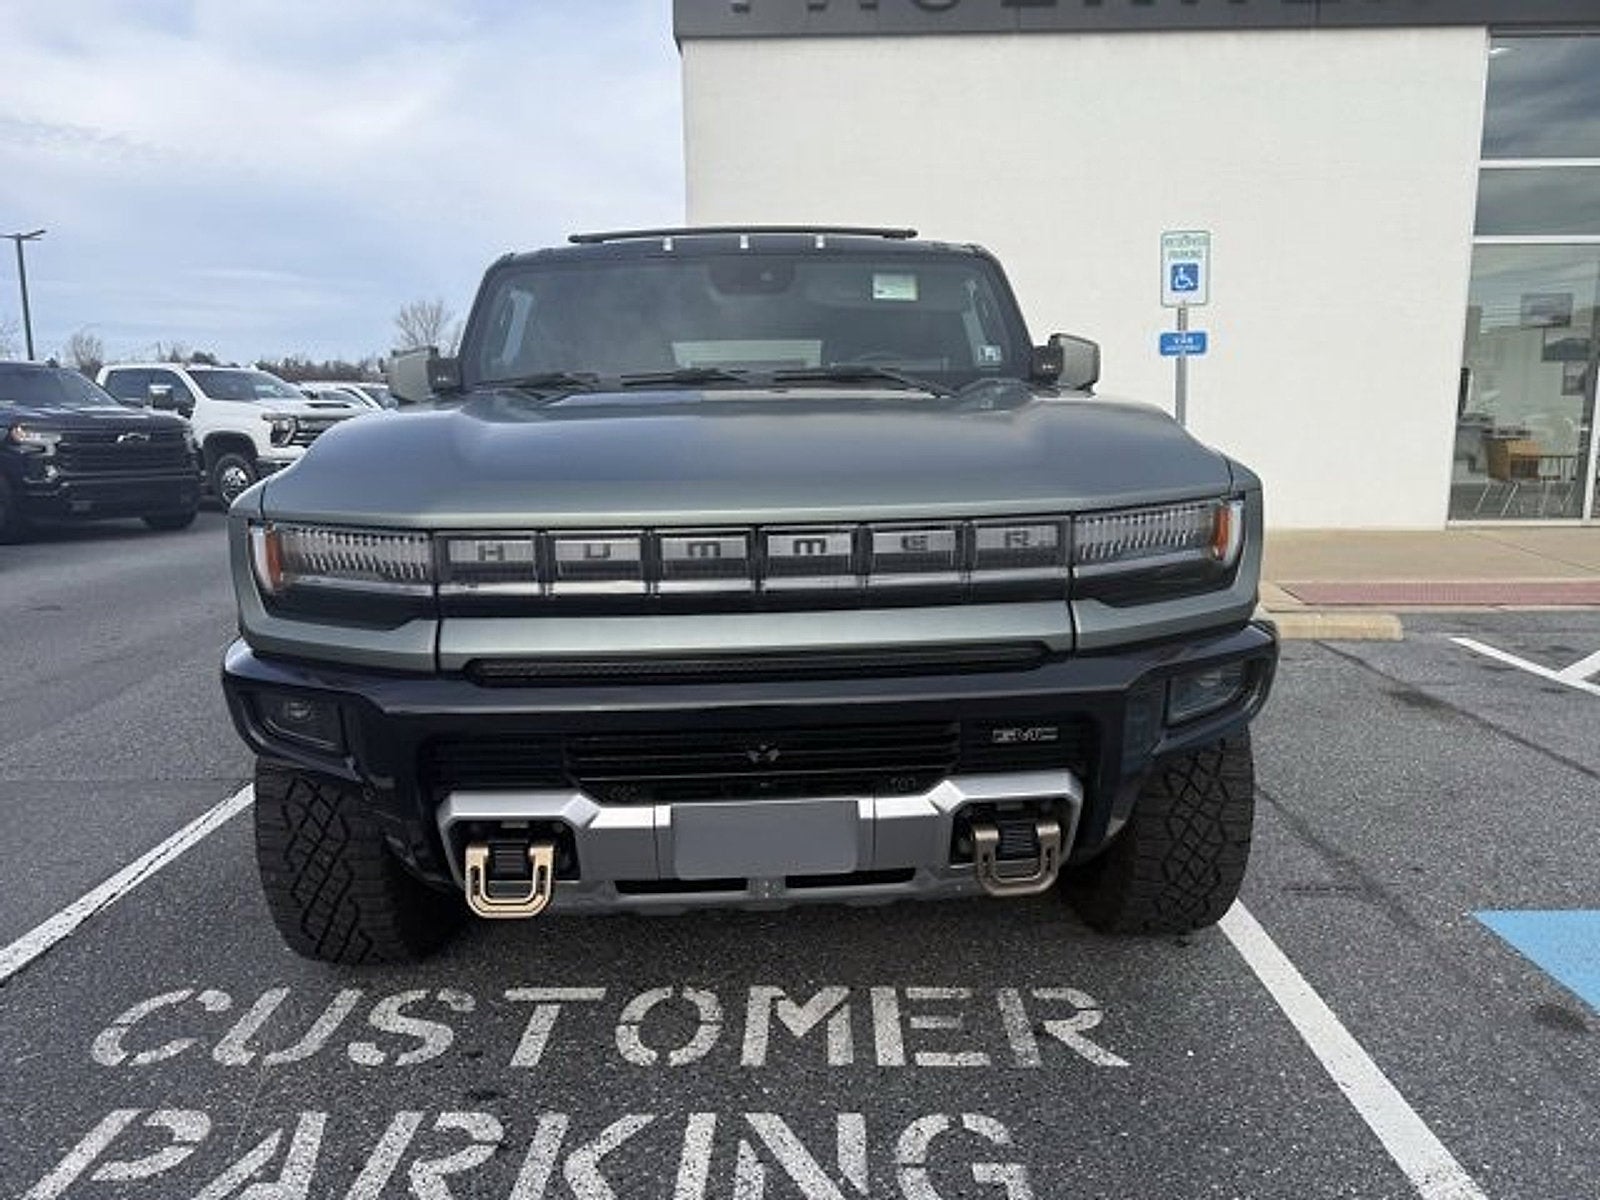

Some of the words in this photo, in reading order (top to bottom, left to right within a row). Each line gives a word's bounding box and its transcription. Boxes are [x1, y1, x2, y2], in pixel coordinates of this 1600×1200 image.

[477, 530, 1029, 561] HUMMER
[91, 987, 1131, 1067] CUSTOMER
[19, 1109, 1035, 1200] PARKING
